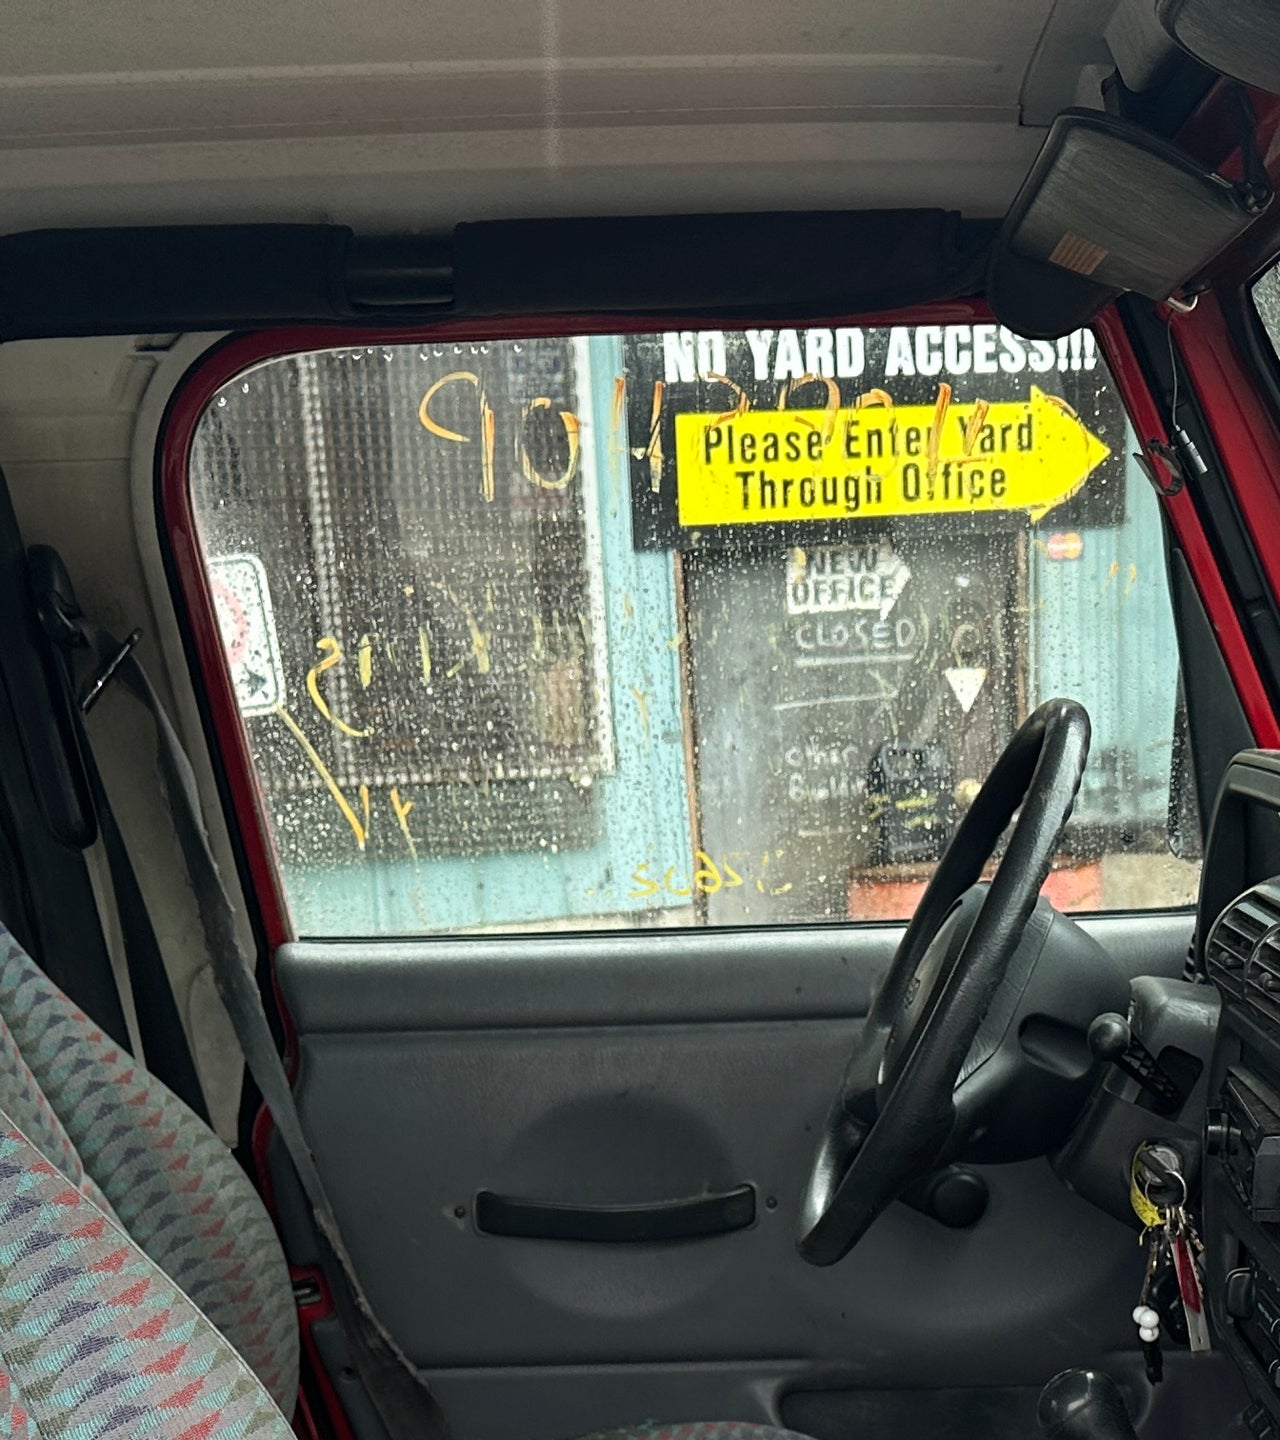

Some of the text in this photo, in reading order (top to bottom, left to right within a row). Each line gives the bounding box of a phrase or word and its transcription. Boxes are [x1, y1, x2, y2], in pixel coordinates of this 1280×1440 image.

[663, 324, 1098, 383] NO YARD ACCESS!!!
[705, 422, 823, 465] Please
[957, 414, 1034, 457] Yard
[736, 468, 882, 512] Through
[807, 546, 877, 576] NEW
[791, 573, 898, 605] OFFICE
[795, 614, 918, 651] CLOSED
